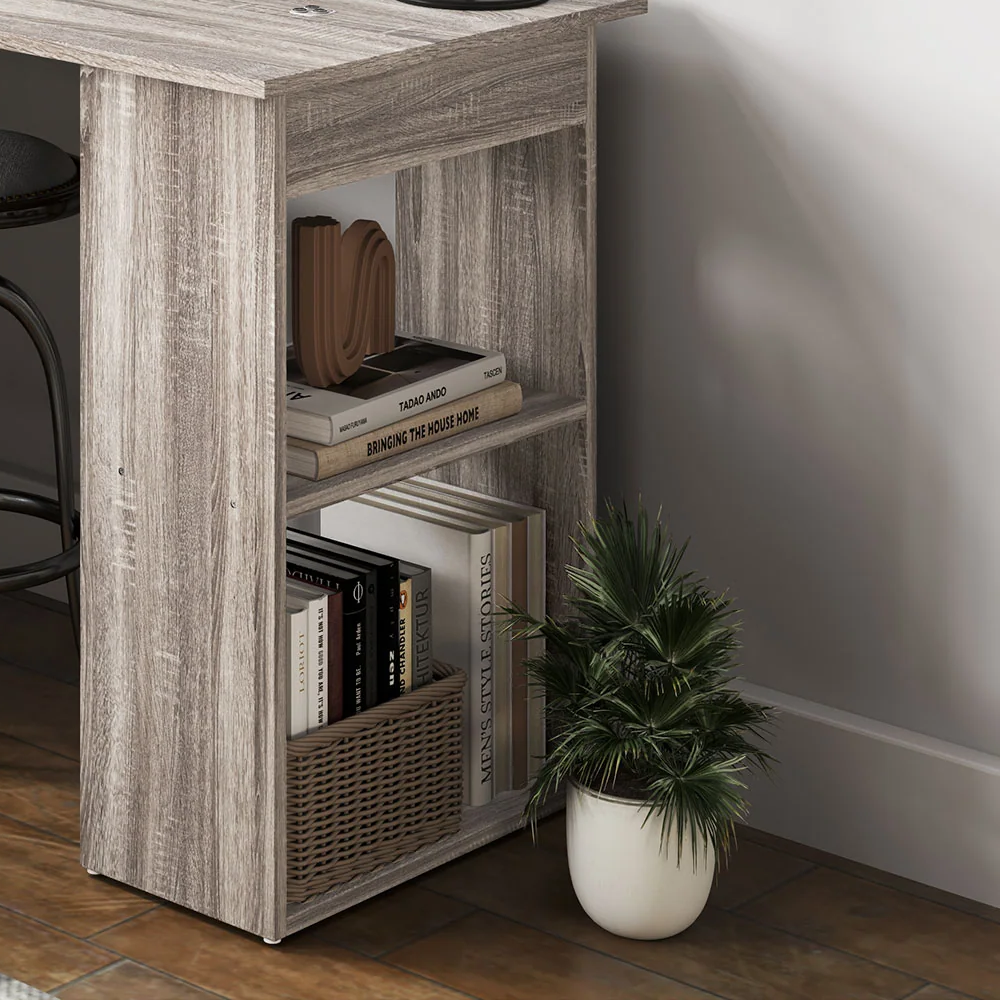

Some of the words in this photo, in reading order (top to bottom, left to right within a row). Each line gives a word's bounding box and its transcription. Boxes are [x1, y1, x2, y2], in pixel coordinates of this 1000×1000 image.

[367, 432, 408, 457] BRINGING
[410, 426, 426, 444] THE
[428, 415, 455, 438] HOUSE
[456, 406, 479, 425] HOME
[399, 395, 424, 412] TADAO
[426, 386, 446, 403] ANDO
[480, 553, 492, 642] STORIES
[416, 588, 429, 687] HITEKTUR
[355, 677, 361, 686] TO
[481, 646, 492, 713] STYLE
[481, 718, 492, 784] MEN'S
